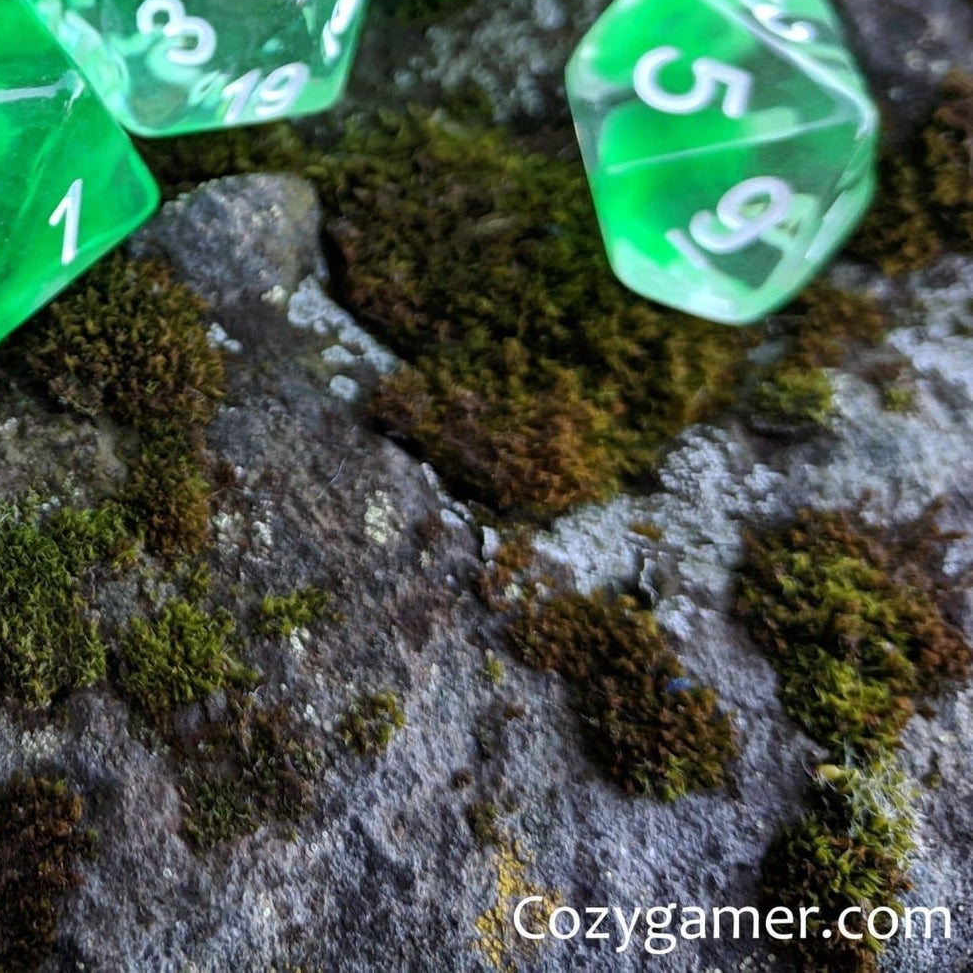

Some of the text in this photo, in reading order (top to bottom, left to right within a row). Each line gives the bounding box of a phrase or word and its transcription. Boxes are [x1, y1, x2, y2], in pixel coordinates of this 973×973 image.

[222, 62, 310, 125] 19
[632, 46, 754, 118] 5
[48, 178, 84, 265] 1
